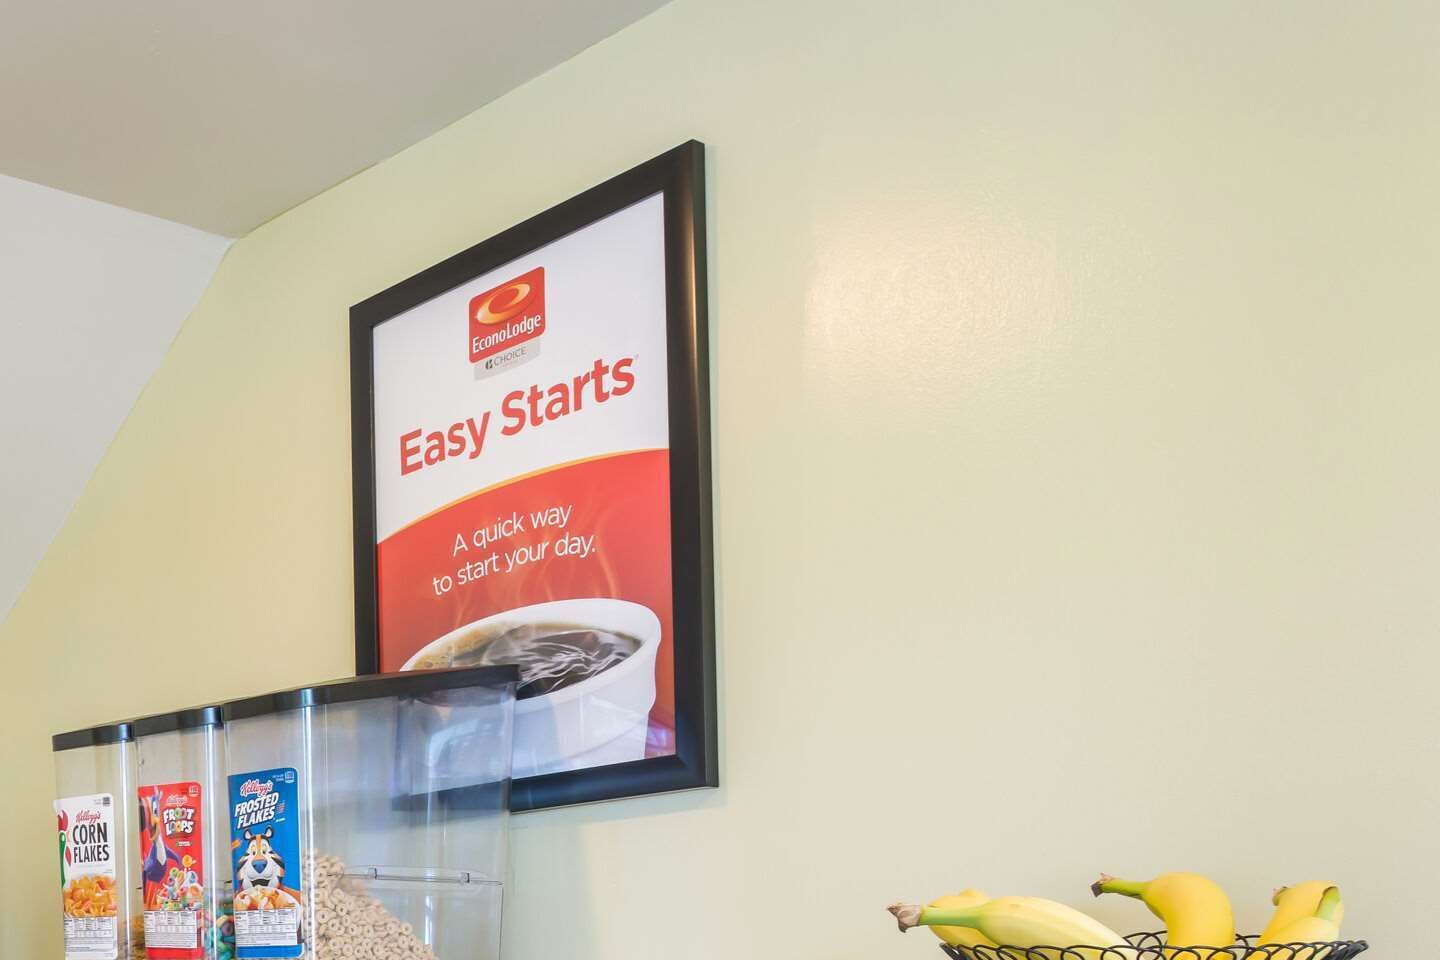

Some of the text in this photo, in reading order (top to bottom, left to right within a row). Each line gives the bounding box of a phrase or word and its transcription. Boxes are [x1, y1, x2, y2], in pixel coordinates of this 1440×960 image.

[472, 314, 541, 353] EconoLodge
[493, 347, 527, 367] CHOICE
[400, 358, 635, 476] Easy Starts
[453, 504, 572, 557] A quick way
[433, 534, 596, 596] to start your day.
[163, 807, 195, 824] FROOT
[234, 792, 280, 817] FROSTED
[165, 820, 194, 836] LOOPS
[237, 806, 275, 829] FLAKES
[72, 822, 108, 845] CORN
[73, 844, 110, 863] FLAKES
